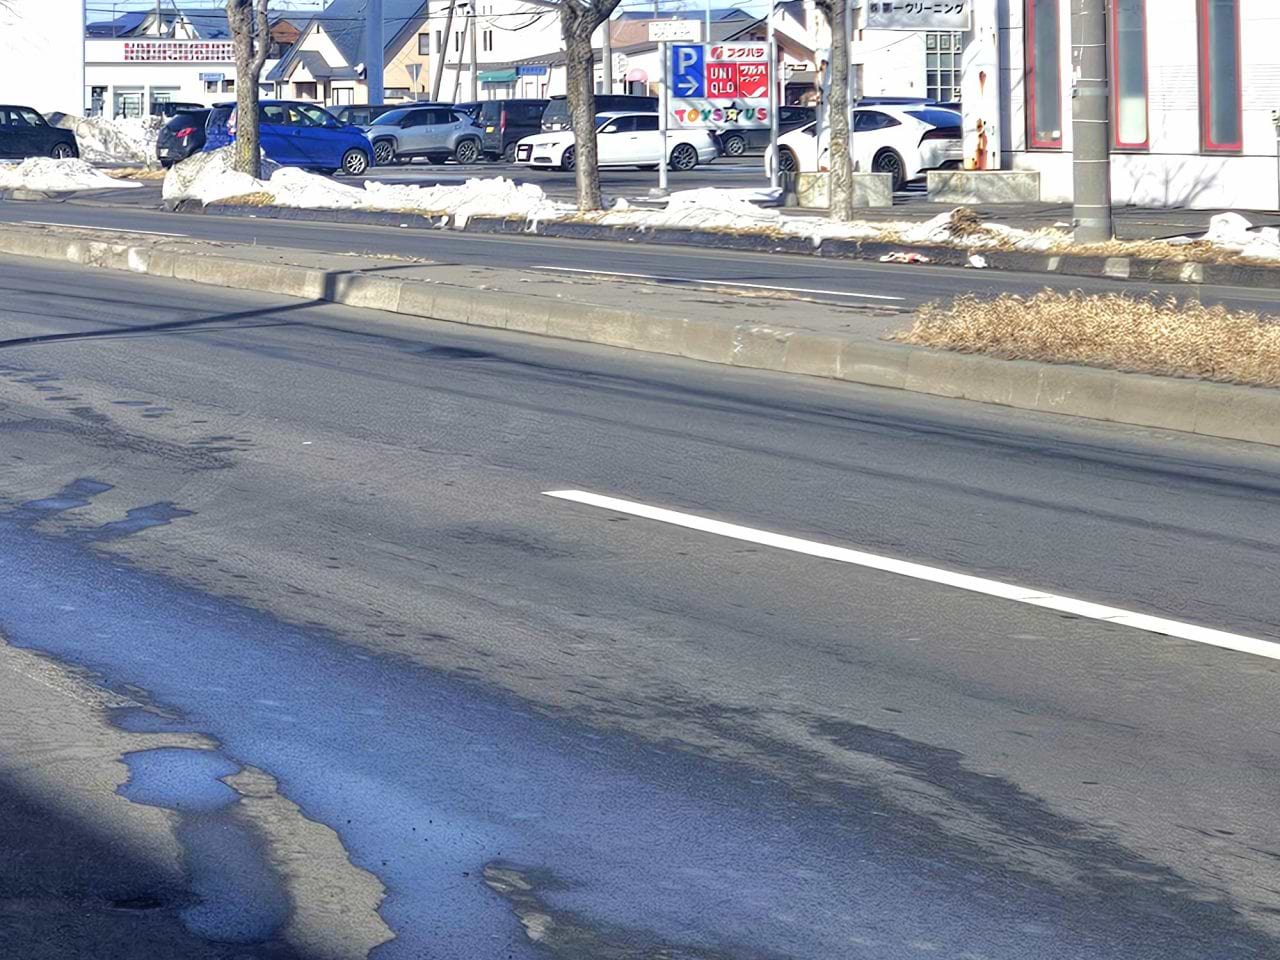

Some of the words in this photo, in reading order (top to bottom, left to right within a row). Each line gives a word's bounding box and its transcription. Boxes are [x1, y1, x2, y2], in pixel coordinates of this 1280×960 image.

[727, 47, 765, 58] フクハラ
[678, 47, 697, 75] P
[710, 67, 732, 80] UNI
[710, 81, 735, 96] QLO
